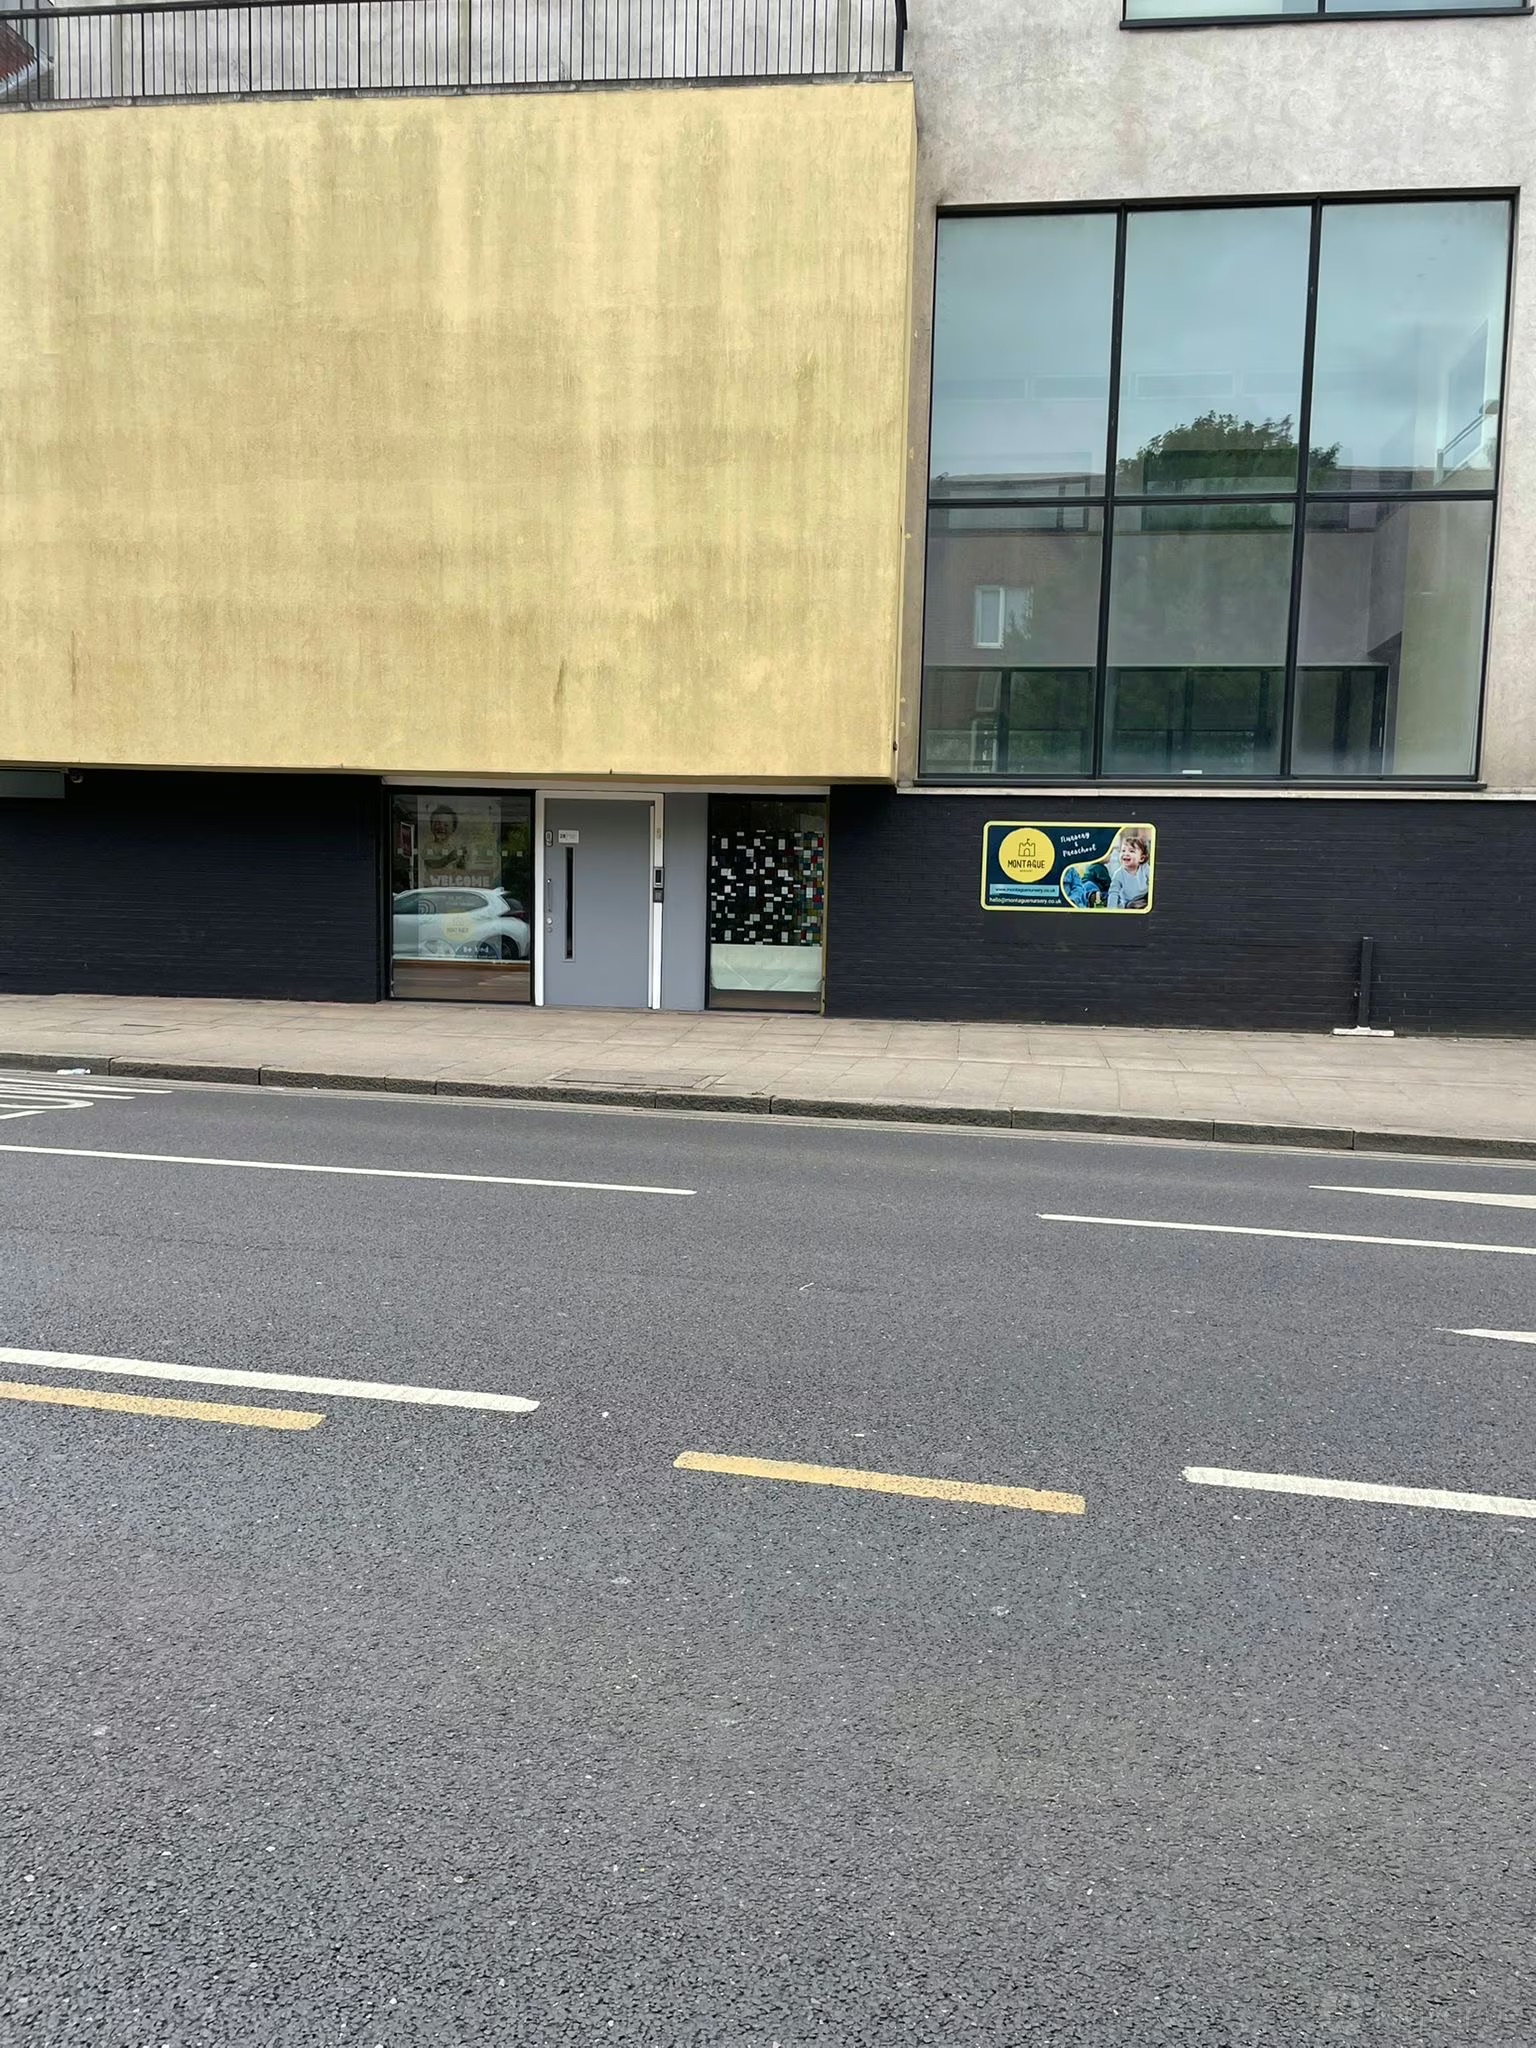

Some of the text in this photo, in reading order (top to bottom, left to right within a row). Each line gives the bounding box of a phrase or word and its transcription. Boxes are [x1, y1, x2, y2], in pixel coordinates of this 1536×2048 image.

[1060, 832, 1090, 843] Nursery
[1062, 843, 1097, 857] Preschool
[1007, 859, 1045, 869] MONTAGUE
[429, 874, 490, 886] WELCOME
